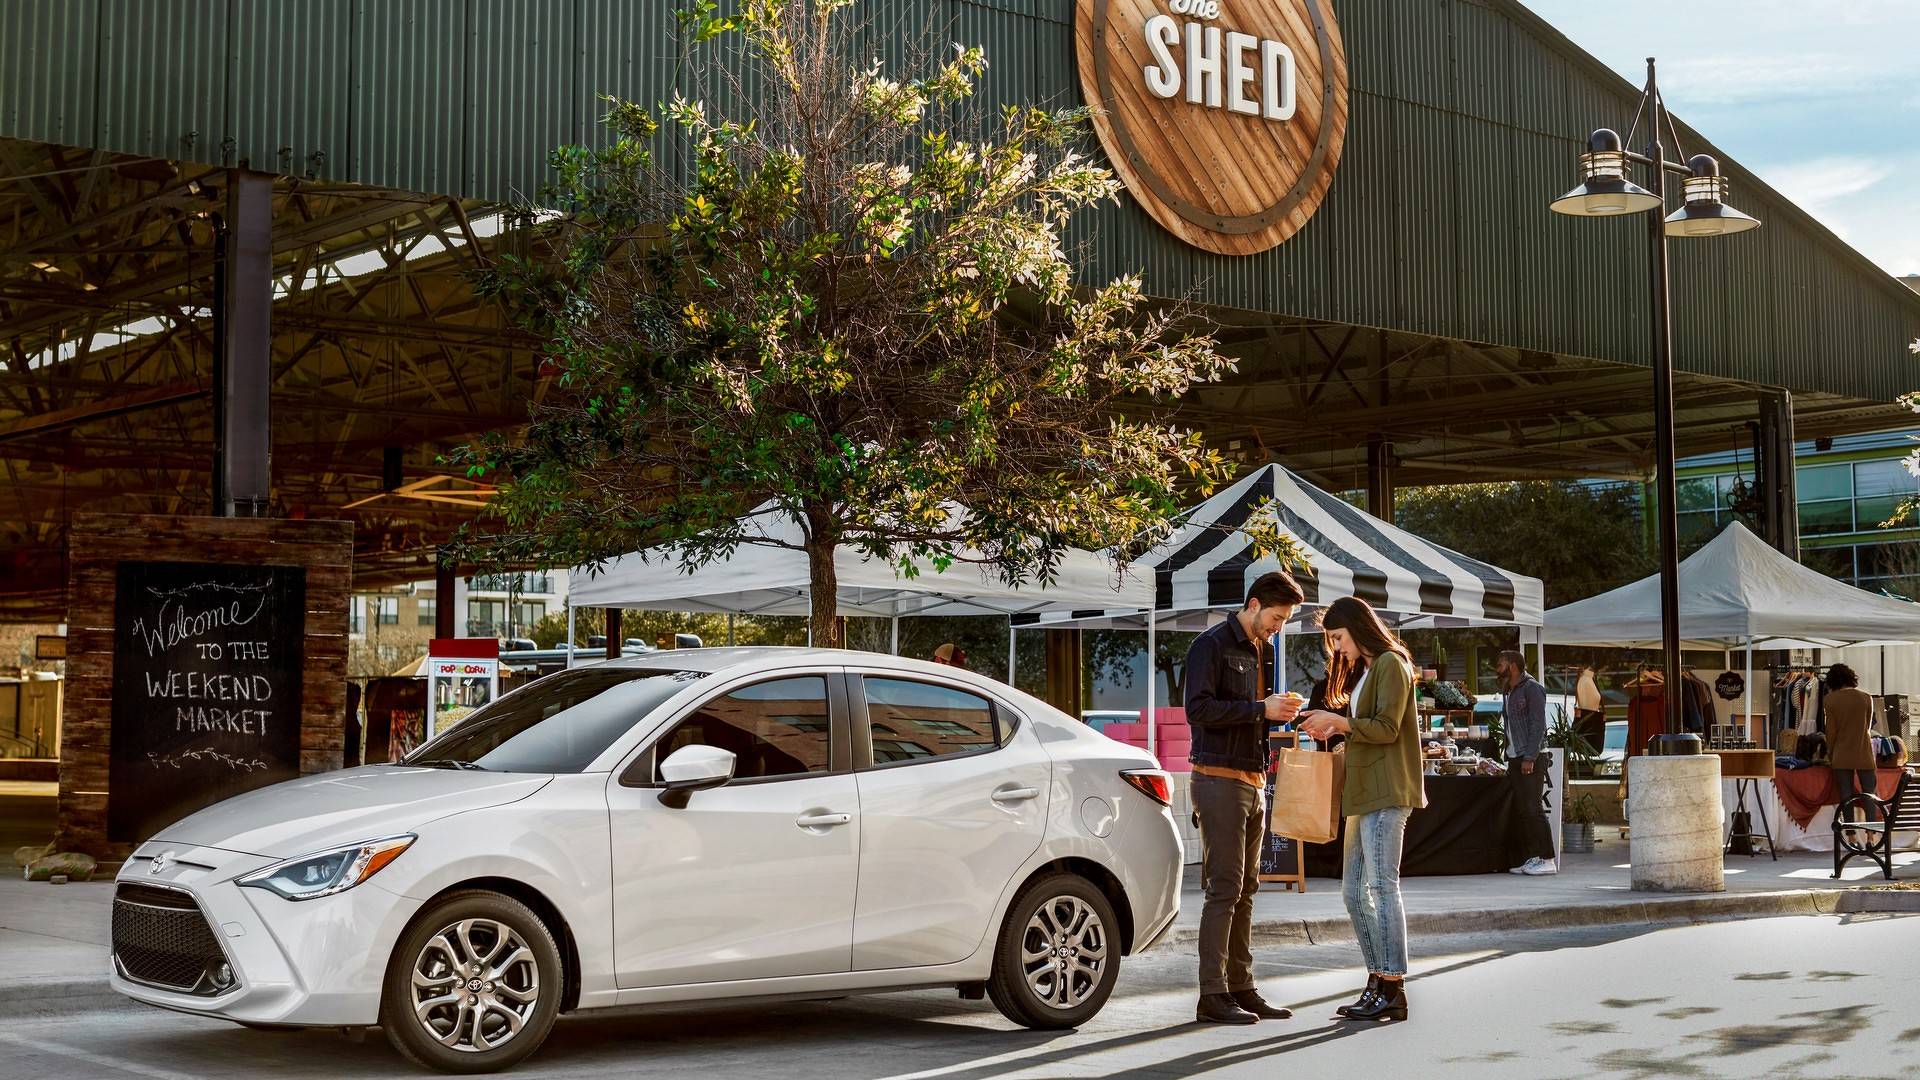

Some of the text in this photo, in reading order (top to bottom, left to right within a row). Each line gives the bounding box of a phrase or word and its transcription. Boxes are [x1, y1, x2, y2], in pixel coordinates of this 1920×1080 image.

[1144, 14, 1297, 121] SHED
[133, 594, 266, 657] Welcome
[196, 641, 270, 660] TO THE
[440, 664, 486, 674] POP CORN
[146, 670, 272, 701] WEEKEND
[176, 706, 272, 736] MARKET
